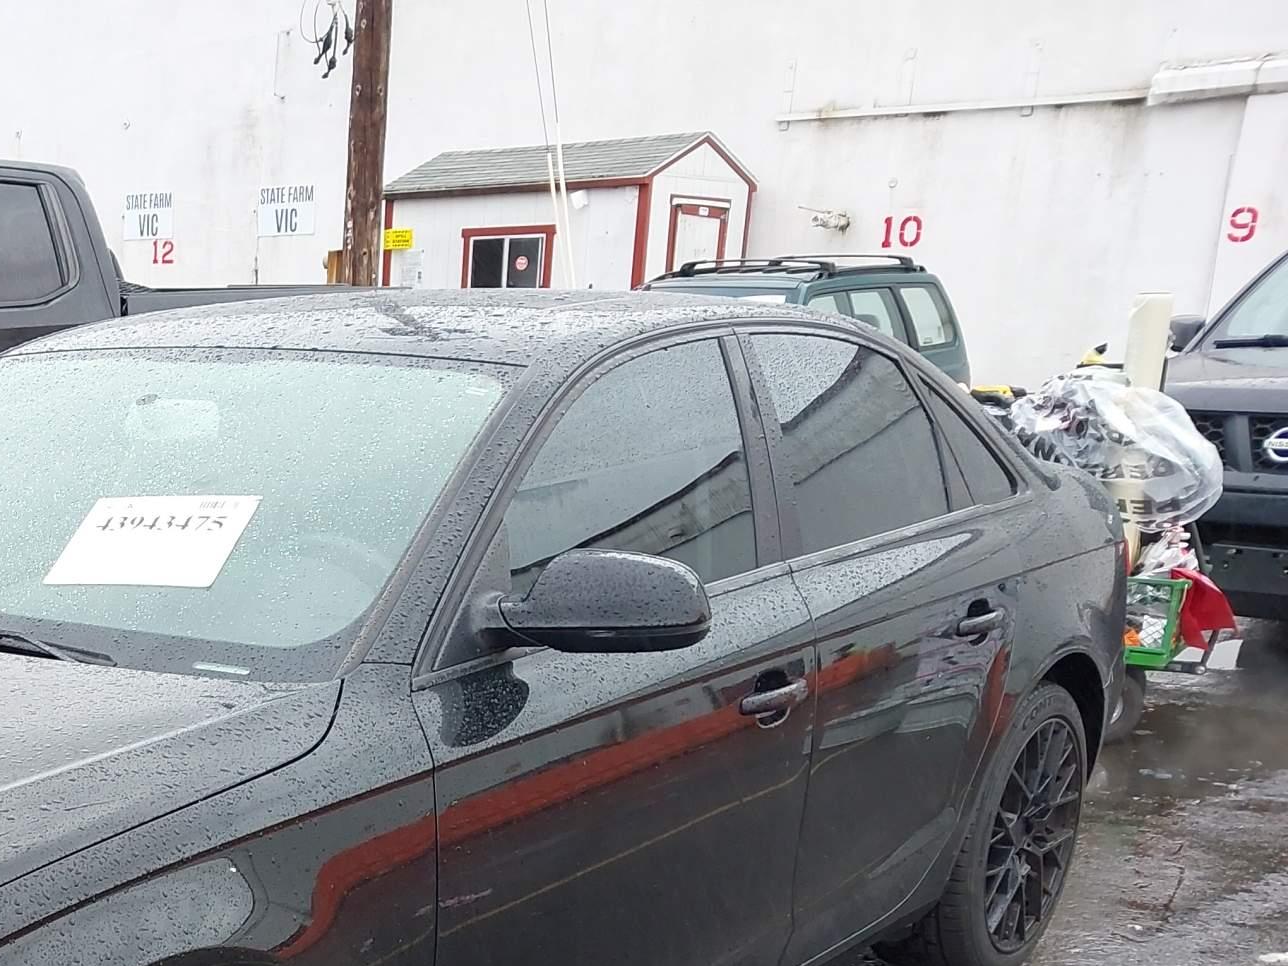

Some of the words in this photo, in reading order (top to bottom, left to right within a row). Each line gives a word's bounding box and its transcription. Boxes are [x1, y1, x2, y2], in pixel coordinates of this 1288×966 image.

[125, 194, 148, 211] STATE
[149, 192, 173, 209] FARM
[260, 187, 286, 205] STATE
[288, 185, 314, 203] FARM
[138, 214, 159, 237] VIC
[275, 208, 298, 233] VIC
[881, 215, 923, 248] 10
[1226, 206, 1259, 242] 9
[152, 239, 174, 265] 12
